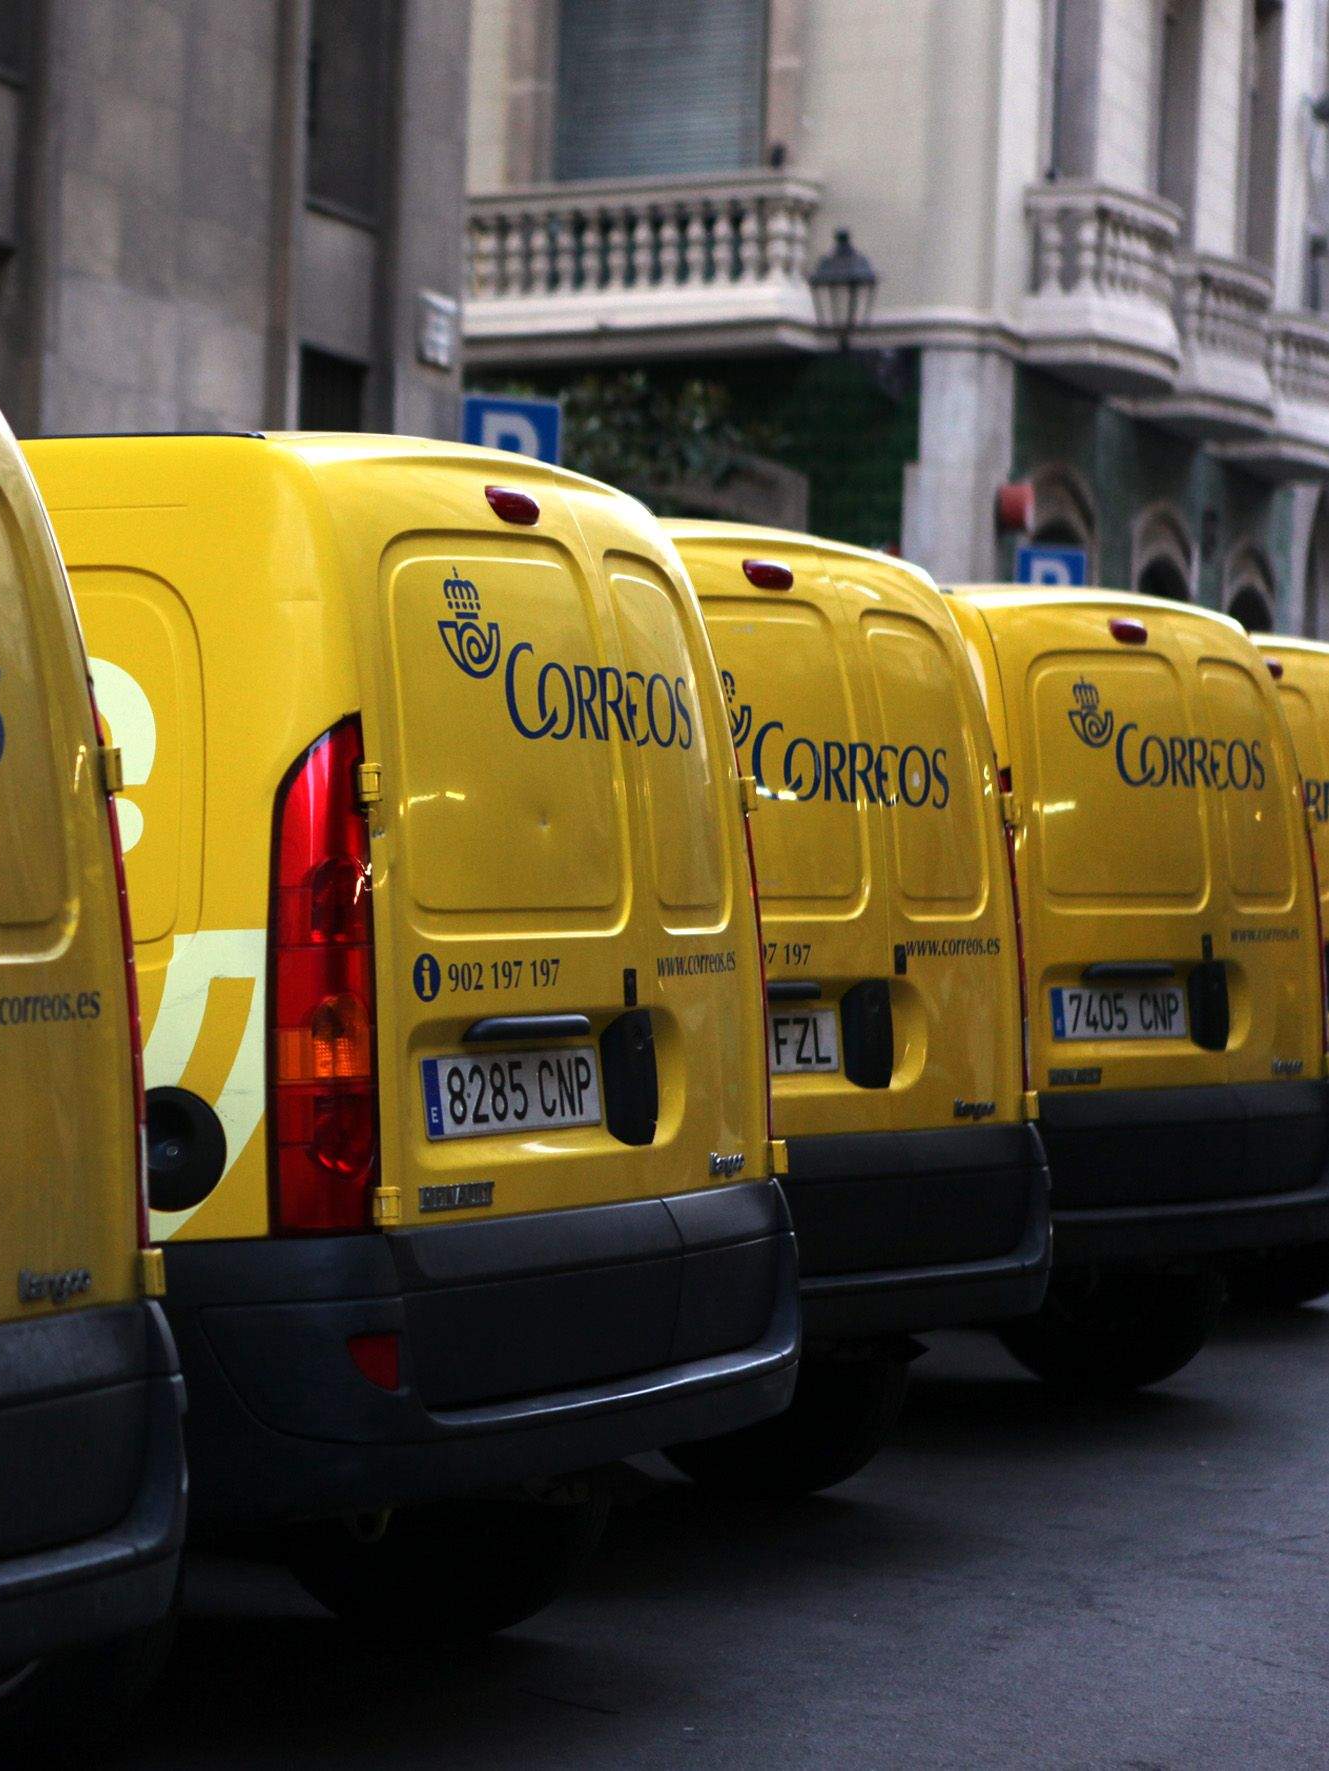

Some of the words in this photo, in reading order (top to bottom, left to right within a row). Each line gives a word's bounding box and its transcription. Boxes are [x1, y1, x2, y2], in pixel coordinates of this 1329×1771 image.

[504, 641, 693, 750] CORREOS
[751, 720, 950, 810] CORREOS
[1115, 722, 1266, 791] CORREOS
[656, 951, 736, 977] www.correos.es
[784, 943, 812, 966] 197
[906, 936, 1001, 957] www.correos.es
[448, 963, 484, 992] 902
[491, 960, 523, 989] 197
[530, 958, 560, 987] 197
[1069, 992, 1128, 1033] 7405
[1139, 991, 1179, 1031] CNP
[772, 1017, 832, 1066] FZL
[446, 1060, 529, 1125] 8285
[538, 1056, 591, 1118] CNP
